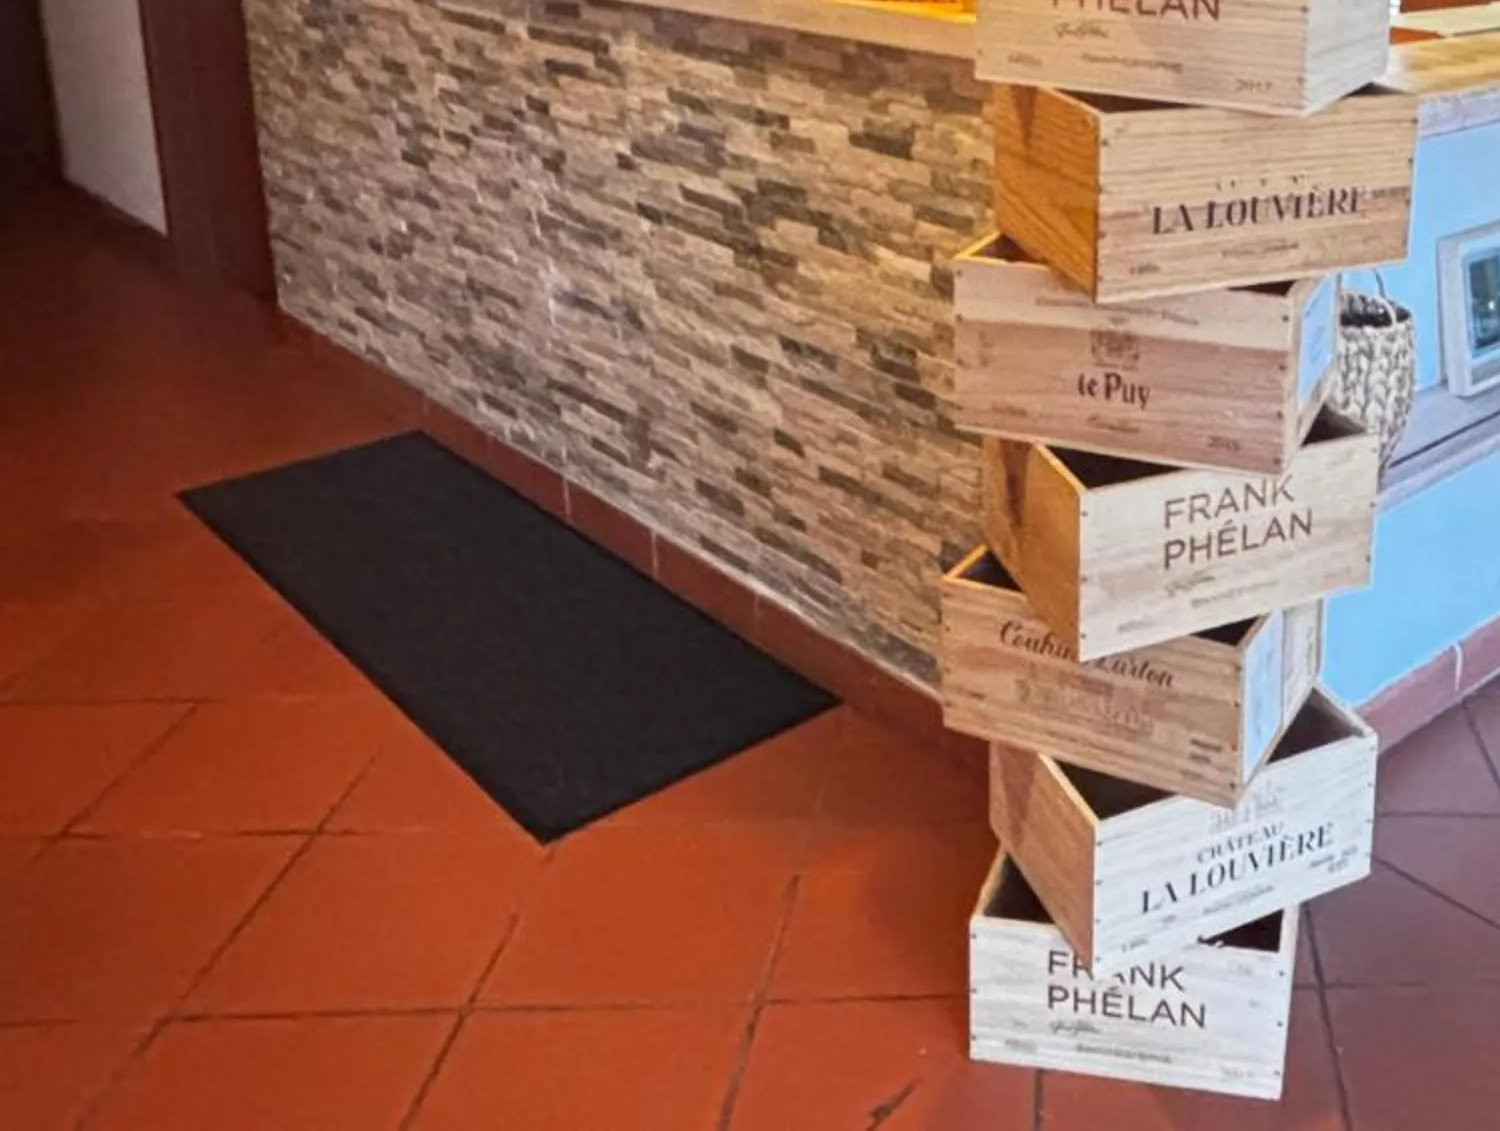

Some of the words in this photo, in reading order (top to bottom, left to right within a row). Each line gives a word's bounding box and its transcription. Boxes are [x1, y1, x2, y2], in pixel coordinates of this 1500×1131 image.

[1153, 203, 1194, 235] LA
[1206, 183, 1365, 229] LOUVIÈRE
[1078, 372, 1099, 397] le
[1105, 372, 1151, 411] Puy
[1164, 474, 1294, 530] FRANK
[1164, 508, 1313, 569] PHÉLAN
[1142, 881, 1178, 913] LA
[1190, 822, 1334, 896] LOUVIÈRE
[1197, 821, 1285, 864] CHÂTEAU
[1048, 985, 1207, 1029] PHÉLAN
